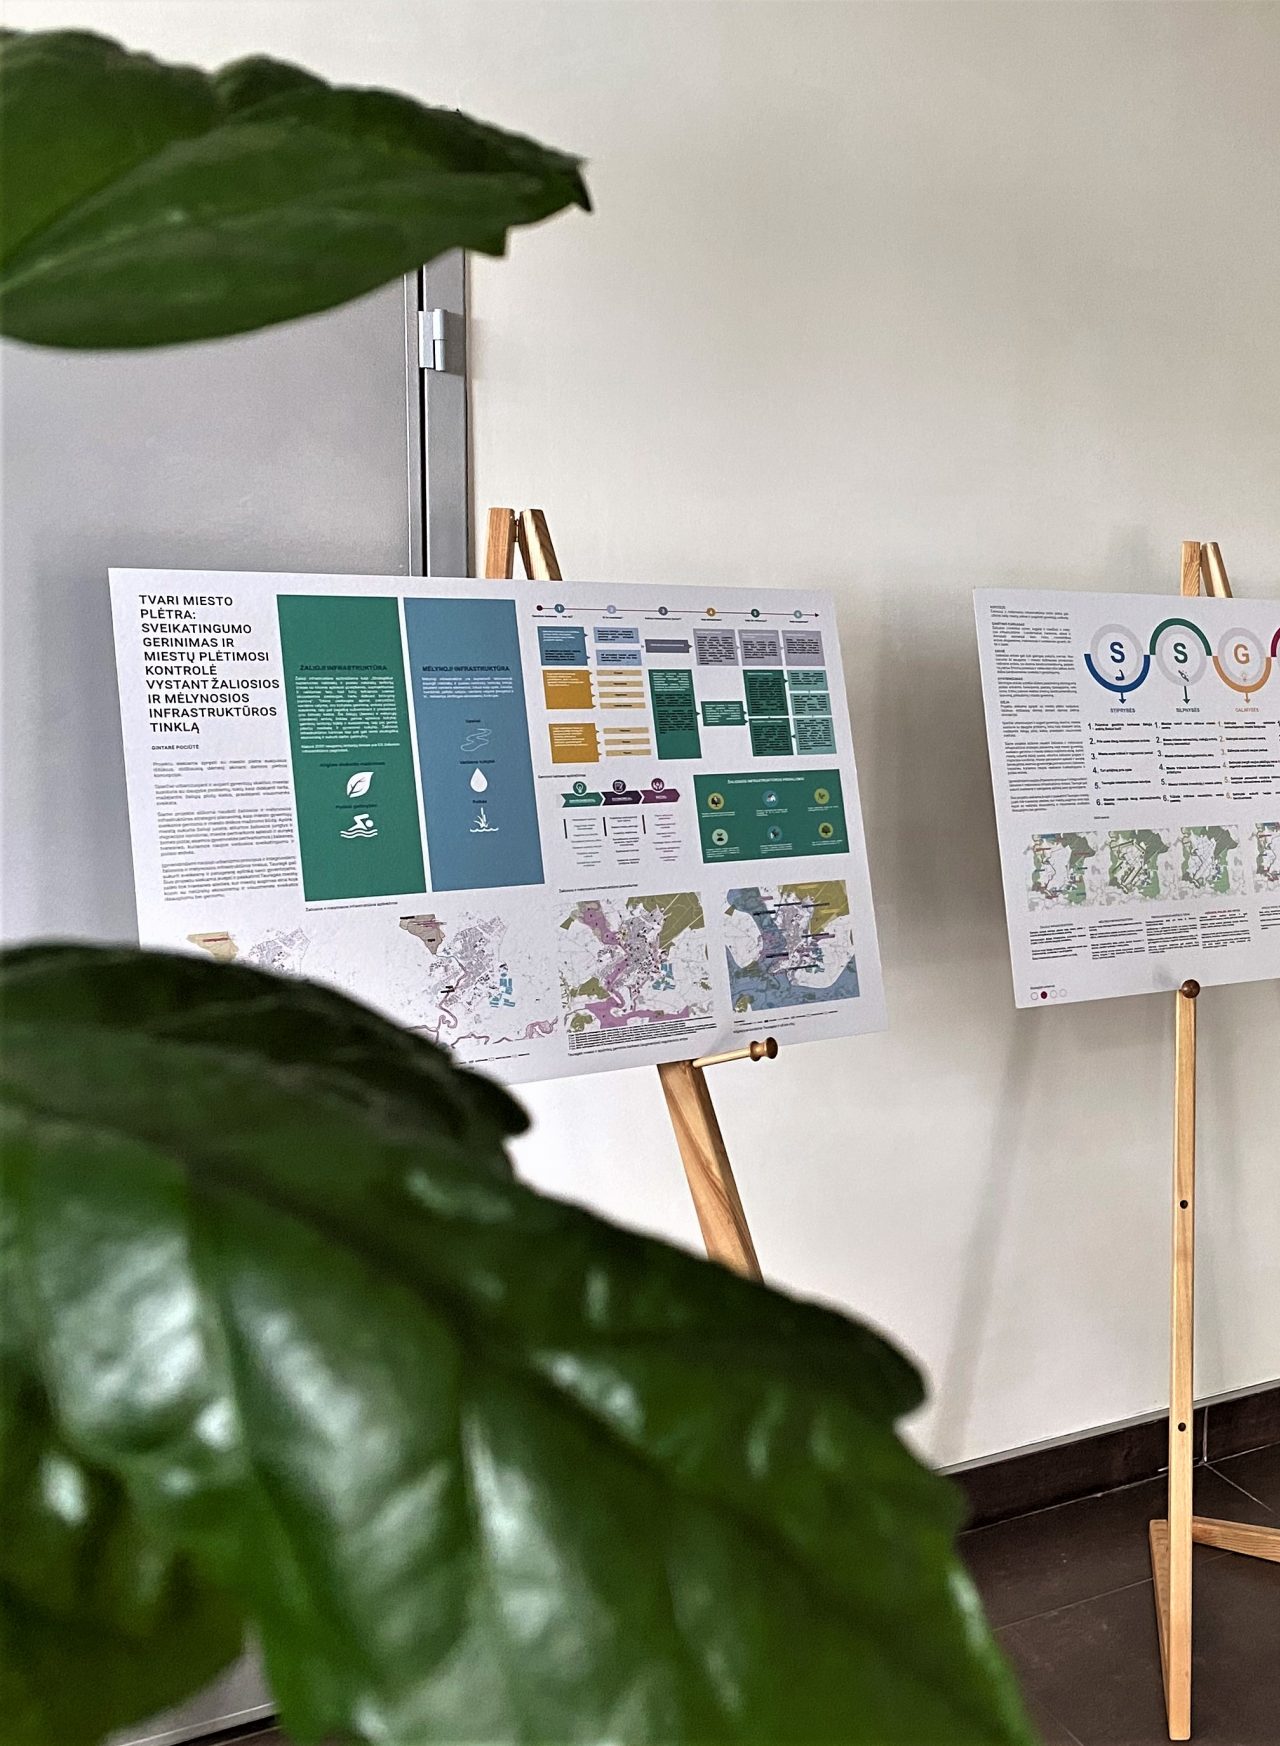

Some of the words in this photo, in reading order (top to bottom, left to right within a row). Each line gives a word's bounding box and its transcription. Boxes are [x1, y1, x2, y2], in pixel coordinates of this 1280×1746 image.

[139, 595, 179, 604] TVARI
[183, 596, 233, 606] MIESTO
[140, 607, 196, 619] PLĖTRA:
[141, 623, 251, 633] SVEIKATINGUMO
[143, 637, 218, 647] GERINIMAS
[222, 638, 234, 647] IR
[144, 652, 195, 663] MIESTŲ
[200, 650, 269, 661] PLĖTIMOSI
[1110, 641, 1125, 664] S
[1173, 643, 1188, 664] S
[1234, 644, 1250, 665] G
[146, 664, 217, 675] KONTROLĖ
[146, 680, 209, 689] VYSTANT
[212, 678, 279, 689] ŽALIOSIOS
[148, 694, 160, 703] IR
[165, 692, 249, 703] MĖLYNOSIOS
[149, 706, 277, 718] INFRASTRUKTŪROS
[150, 722, 199, 734] TINKLĄ
